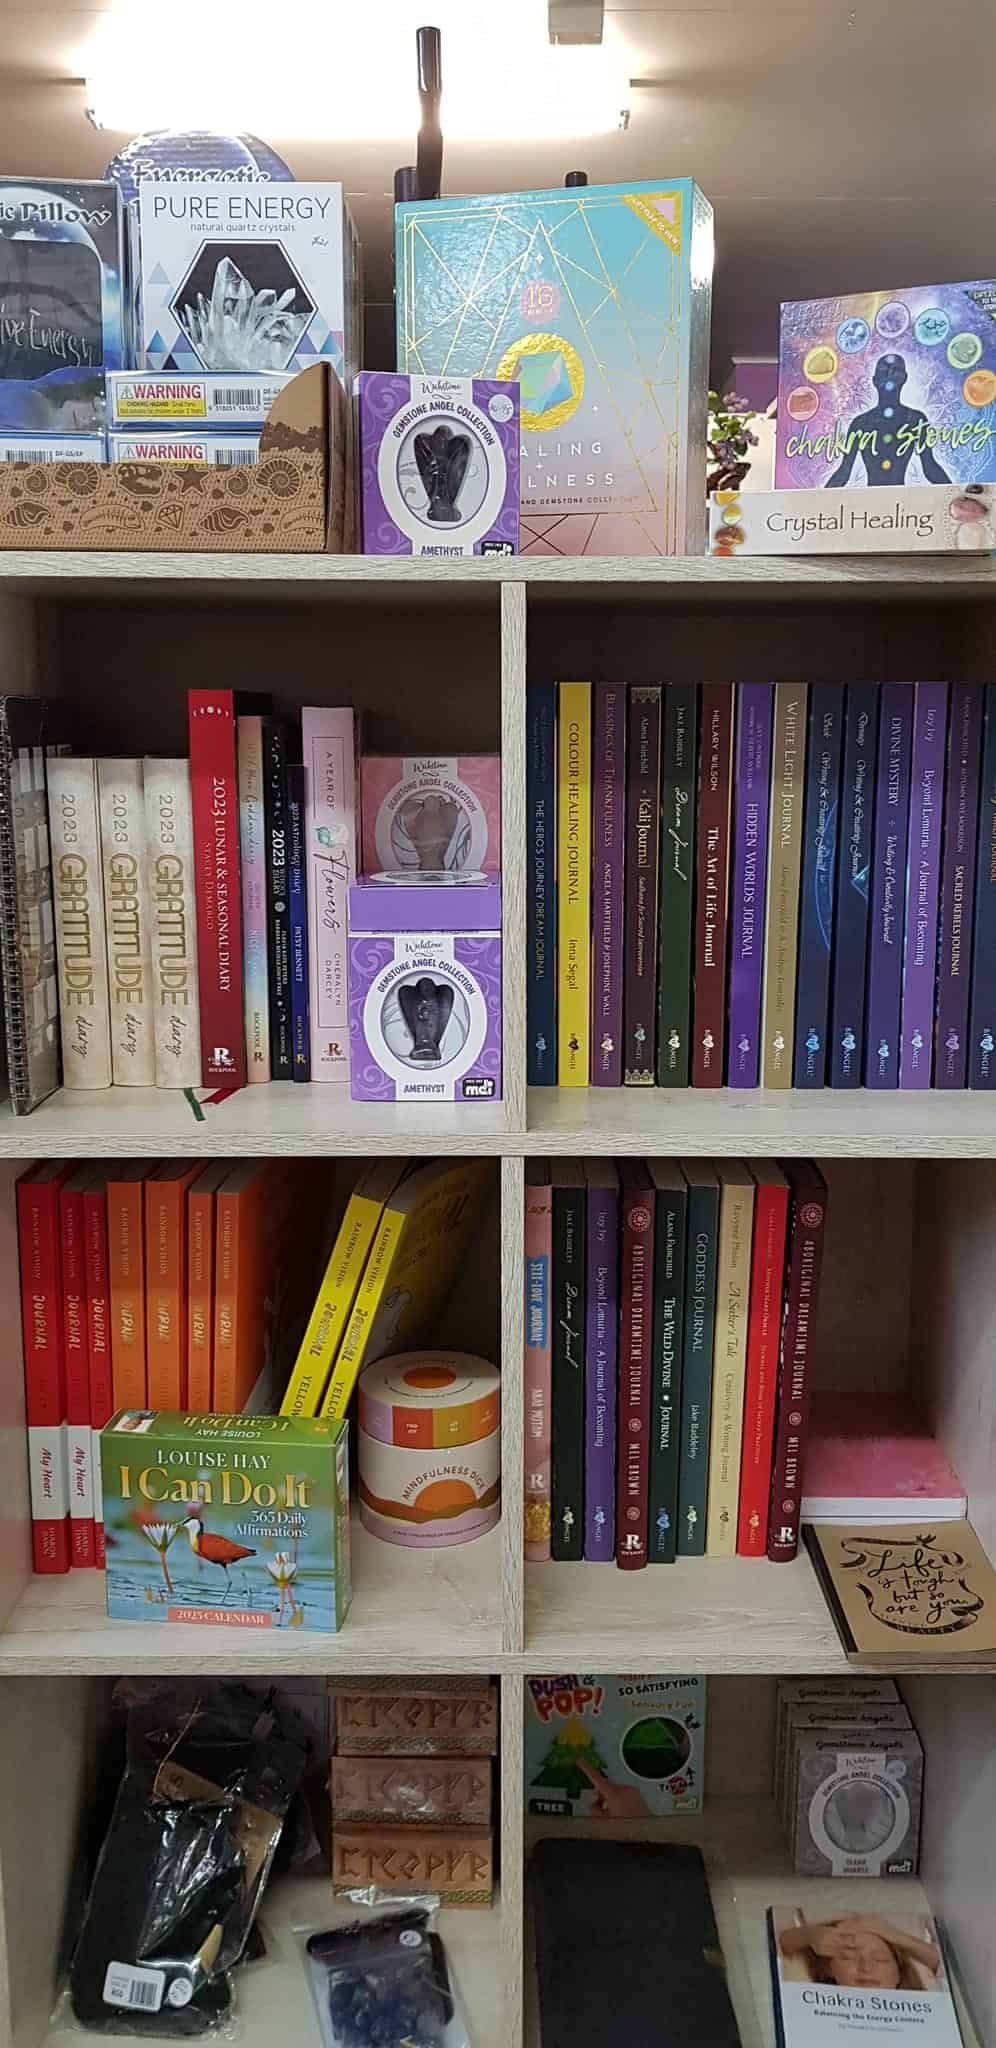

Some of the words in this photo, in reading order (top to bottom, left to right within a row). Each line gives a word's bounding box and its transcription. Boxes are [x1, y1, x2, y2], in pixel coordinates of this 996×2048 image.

[18, 201, 112, 226] Pillow
[154, 196, 217, 219] PURE
[228, 196, 331, 219] ENERGY
[190, 222, 224, 232] natural
[226, 222, 256, 234] quartz
[258, 222, 297, 234] crystals
[29, 306, 93, 369] Energy
[133, 384, 201, 400] WARNING
[393, 405, 428, 439] GEMSTONE
[430, 400, 455, 412] ANGEL
[457, 404, 496, 447] COLLECTION
[786, 417, 878, 462] chakra
[896, 417, 993, 457] stones
[135, 445, 203, 460] WARNING
[520, 443, 602, 459] ALING
[520, 499, 537, 507] AND
[540, 498, 583, 507] GEMSTONE
[528, 476, 614, 496] LNESS
[766, 504, 844, 541] Crystal
[850, 504, 933, 537] Healing
[421, 545, 464, 556] AMETHYST
[711, 709, 719, 750] HILLARY
[785, 702, 799, 746] WHITE
[924, 728, 935, 743] Ivy
[326, 751, 332, 759] A
[569, 722, 580, 777] COLOUR
[326, 761, 334, 793] YEAR
[710, 754, 718, 791] WILSON
[783, 750, 797, 787] LIGHT
[211, 777, 227, 817] 2023
[327, 795, 335, 809] OF
[921, 769, 936, 806] Beyond
[61, 793, 79, 844] 2023
[111, 792, 127, 843] 2023
[158, 793, 174, 844] 2023
[536, 800, 544, 818] THE
[568, 782, 580, 841] HEALING
[746, 803, 759, 847] HIDDEN
[781, 792, 795, 849] JOURNAL
[215, 820, 227, 865] LUNAR
[536, 820, 545, 854] HERO'S
[707, 827, 719, 851] The
[921, 808, 933, 849] Lemuria
[272, 829, 286, 867] 2023
[707, 853, 718, 873] Art
[920, 860, 929, 868] A
[216, 868, 227, 880] &
[272, 868, 280, 895] DIARY
[313, 850, 351, 934] Flowers
[536, 856, 545, 900] JOURNEY
[568, 846, 579, 905] JOURNAL
[706, 876, 717, 890] of
[744, 851, 757, 903] WORLDS
[918, 870, 930, 905] Journal
[953, 864, 964, 901] SACRED
[217, 883, 229, 948] SEASONAL
[536, 903, 544, 936] DREAM
[705, 895, 717, 918] Life
[918, 907, 929, 917] of
[951, 903, 962, 935] REBELS
[58, 853, 94, 1006] GRATITUDE
[109, 852, 143, 1004] GRATITUDE
[155, 853, 188, 1006] GRATITUDE
[294, 926, 302, 946] PATSY
[703, 921, 716, 967] Journal
[741, 907, 754, 960] JOURNAL
[913, 921, 927, 966] Becoming
[295, 948, 303, 982] BENNETT
[536, 938, 544, 981] JOURNAL
[569, 939, 578, 961] Inna
[950, 935, 961, 977] JOURNAL
[219, 952, 231, 993] DIARY
[325, 960, 333, 1000] DARCEY
[377, 961, 411, 993] GEMSTONE
[412, 958, 436, 970] ANGEL
[438, 960, 476, 996] COLLECTION
[566, 964, 578, 990] Segal
[73, 1015, 93, 1058] diary
[124, 1013, 142, 1056] diary
[167, 1015, 187, 1058] diary
[403, 1083, 446, 1094] AMETHYST
[465, 1079, 494, 1096] mdi
[223, 1210, 231, 1249] RAINBOW
[666, 1211, 676, 1237] ALANA
[631, 1245, 645, 1302] ABORIGINAL
[665, 1239, 675, 1279] FAIRCHILD
[695, 1233, 709, 1293] GODDESS
[800, 1240, 814, 1298] ABORIGINAL
[595, 1264, 608, 1300] Beyond
[67, 1295, 81, 1350] JOURNAL
[596, 1302, 607, 1339] Lemuria
[664, 1297, 676, 1319] THE
[692, 1296, 707, 1352] JOURNAL
[630, 1307, 643, 1361] DREAMTIME
[663, 1320, 675, 1349] WILD
[795, 1302, 810, 1355] DREAMTIME
[596, 1359, 606, 1391] Journal
[629, 1366, 642, 1407] JOURNAL
[662, 1351, 674, 1388] DIVINE
[791, 1360, 806, 1400] JOURNAL
[596, 1393, 605, 1403] of
[691, 1404, 700, 1421] Jake
[223, 1431, 261, 1439] LOUISE
[594, 1406, 605, 1447] Becoming
[660, 1406, 673, 1450] JOURNAL
[688, 1423, 700, 1460] Baddeley
[787, 1436, 799, 1453] MEL
[40, 1448, 50, 1466] My
[73, 1446, 85, 1465] My
[157, 1450, 227, 1468] LOUISE
[233, 1453, 271, 1469] HAY
[628, 1443, 641, 1462] MEL
[43, 1470, 53, 1498] Heart
[76, 1468, 86, 1497] Heart
[119, 1465, 131, 1498] I
[138, 1467, 213, 1505] Can
[221, 1471, 277, 1507] Do
[283, 1474, 312, 1509] It
[402, 1465, 469, 1501] MINDFULNESS
[628, 1464, 641, 1496] BROWN
[784, 1458, 797, 1489] BROWN
[233, 1523, 309, 1539] Affirmations
[251, 1510, 275, 1524] 365
[277, 1510, 307, 1527] Daily
[867, 1548, 945, 1578] Life
[877, 1578, 897, 1589] is
[902, 1569, 953, 1591] tough
[886, 1605, 920, 1615] are
[893, 1589, 925, 1603] but
[929, 1591, 945, 1602] so
[204, 1612, 265, 1625] CALENDAR
[535, 1686, 604, 1722] POP!
[618, 1687, 634, 1697] SO
[637, 1677, 699, 1694] SATISFYING
[802, 1990, 864, 2010] Chakra
[871, 1996, 933, 2014] Stones
[853, 2012, 865, 2021] the
[867, 2014, 893, 2024] Energy
